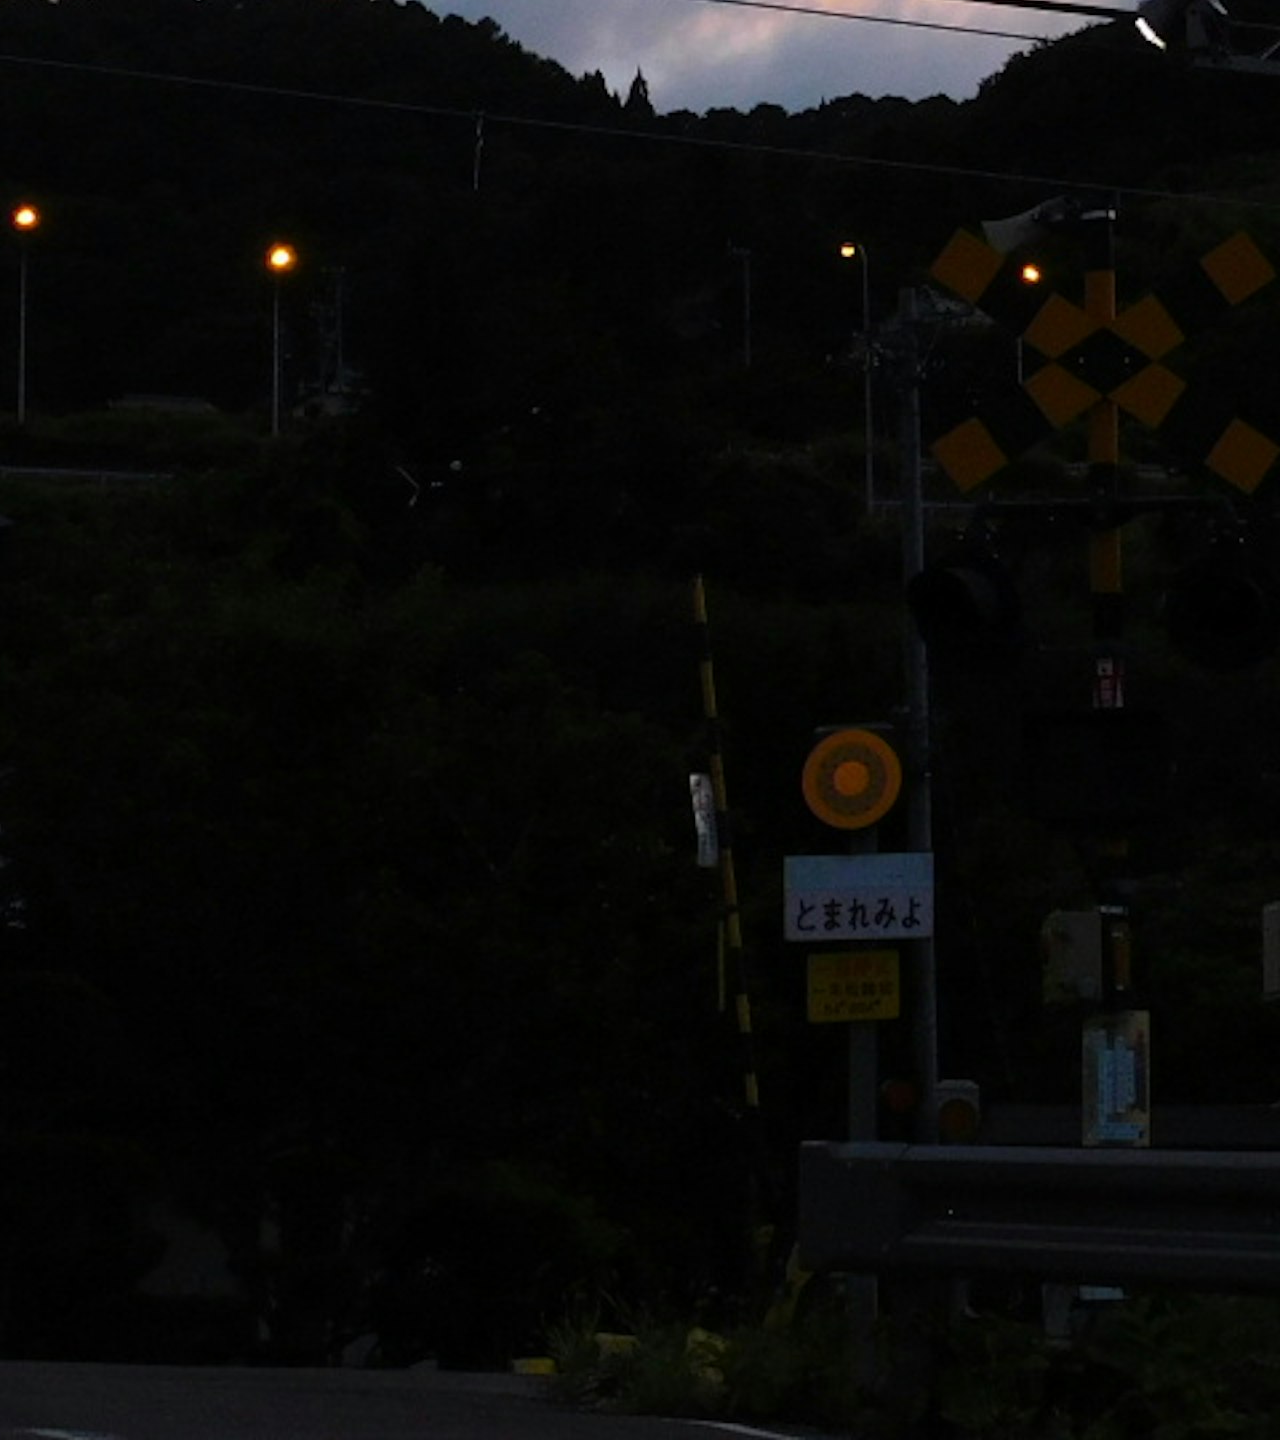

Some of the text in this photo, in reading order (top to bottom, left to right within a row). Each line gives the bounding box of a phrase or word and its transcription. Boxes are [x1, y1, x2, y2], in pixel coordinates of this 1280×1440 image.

[797, 897, 921, 931] とまれみよ
